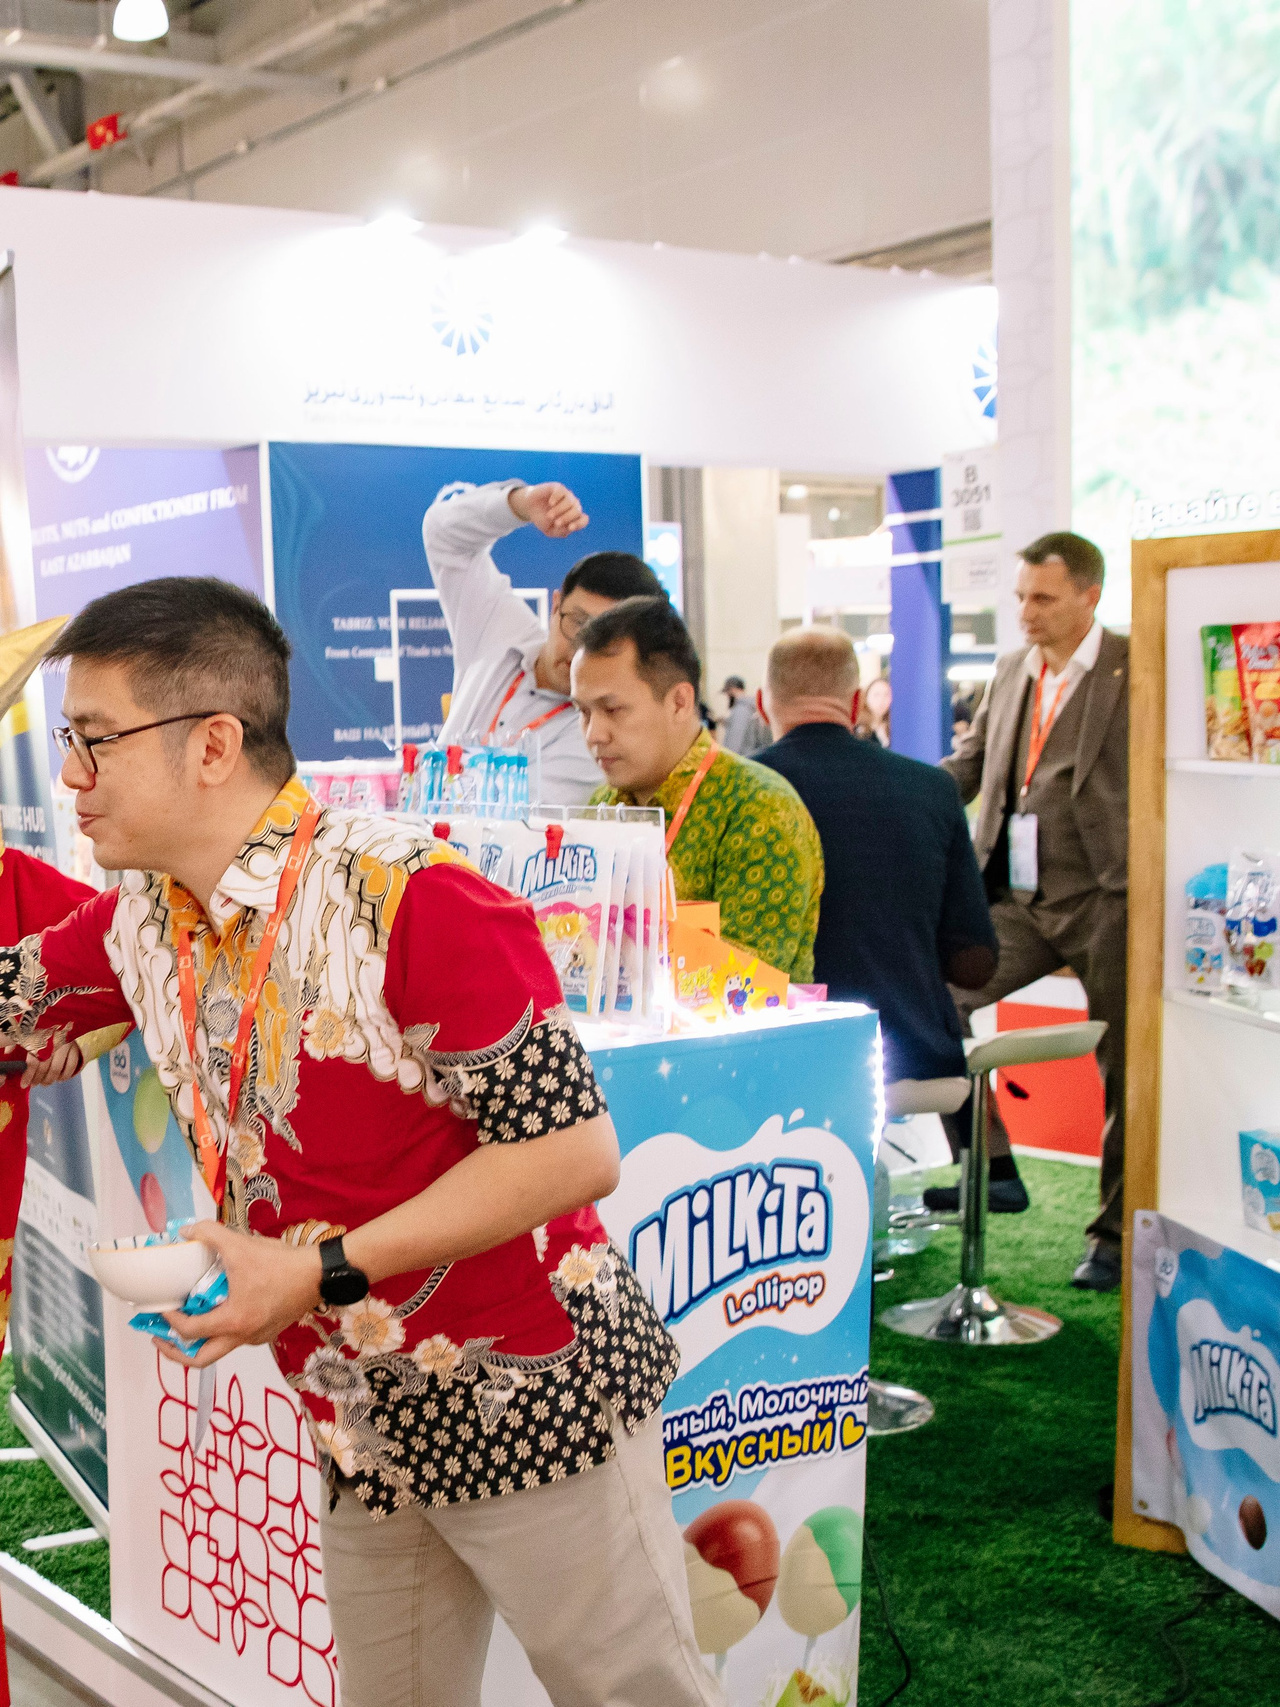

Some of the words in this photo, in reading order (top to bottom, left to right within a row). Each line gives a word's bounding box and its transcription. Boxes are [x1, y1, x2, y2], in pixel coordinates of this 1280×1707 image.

[964, 465, 978, 484] B
[724, 1273, 824, 1325] Lollipop
[665, 1410, 835, 1489] Вкусный
